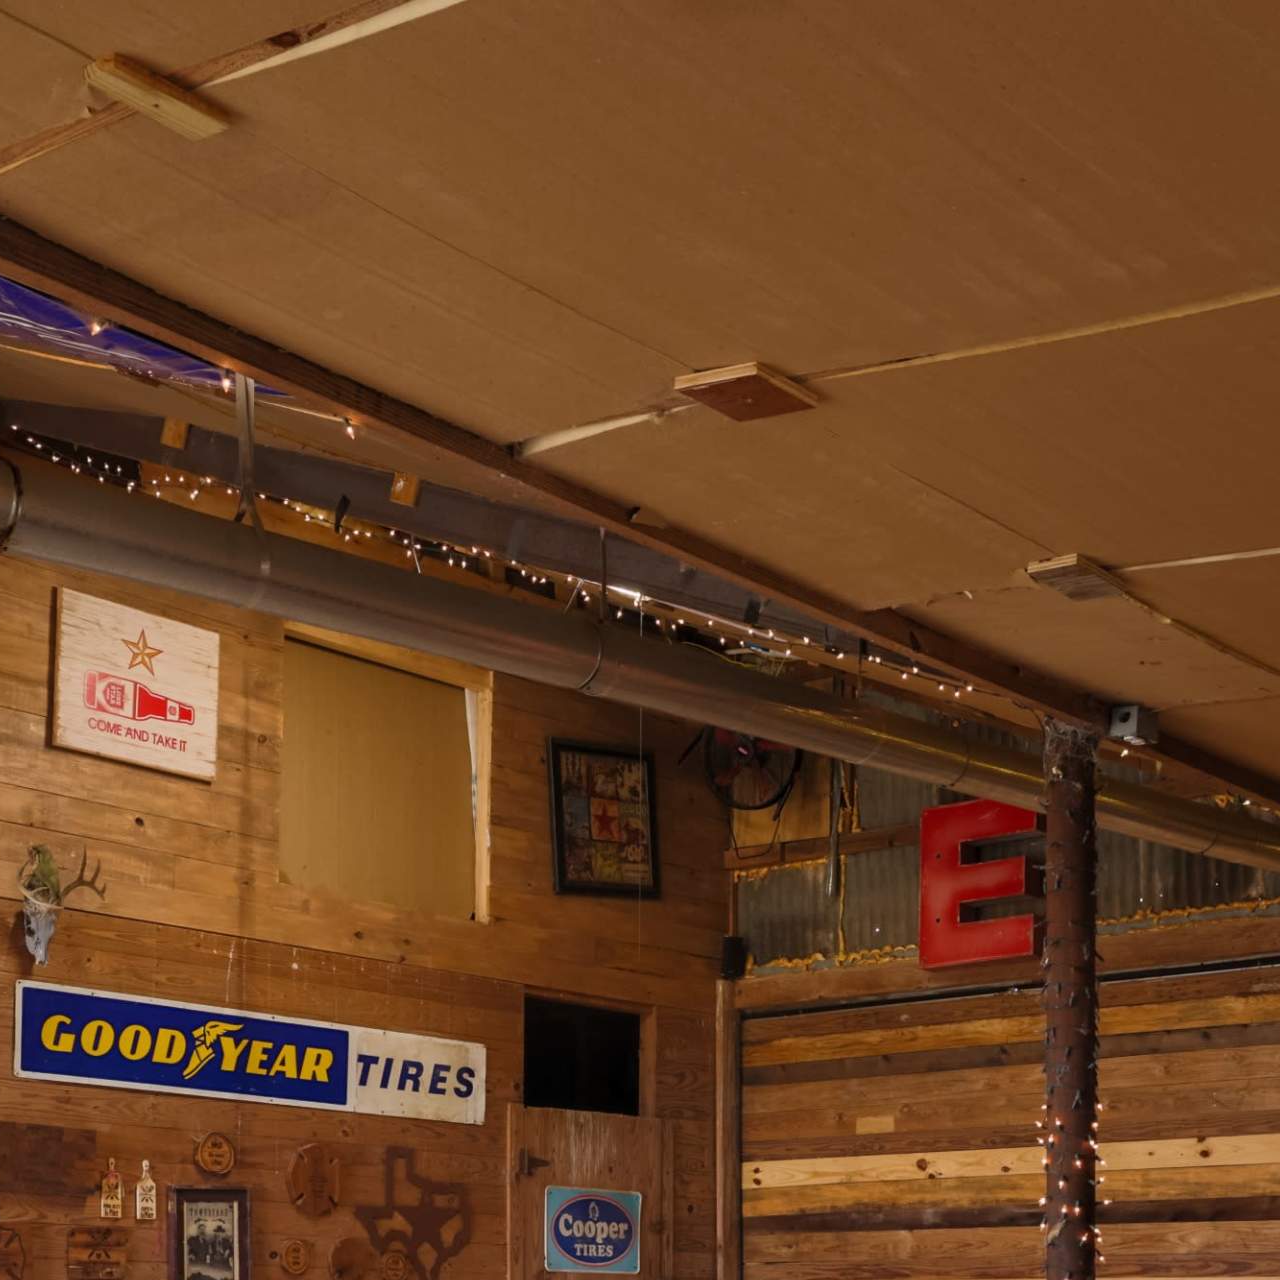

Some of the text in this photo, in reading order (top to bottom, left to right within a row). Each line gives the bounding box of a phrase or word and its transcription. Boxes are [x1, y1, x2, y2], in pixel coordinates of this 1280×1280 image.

[88, 717, 187, 752] COME AND TAKE IT
[920, 798, 1038, 970] E
[357, 1054, 476, 1099] TIRES
[558, 1213, 628, 1243] Cooper
[574, 1243, 614, 1257] TIRES
